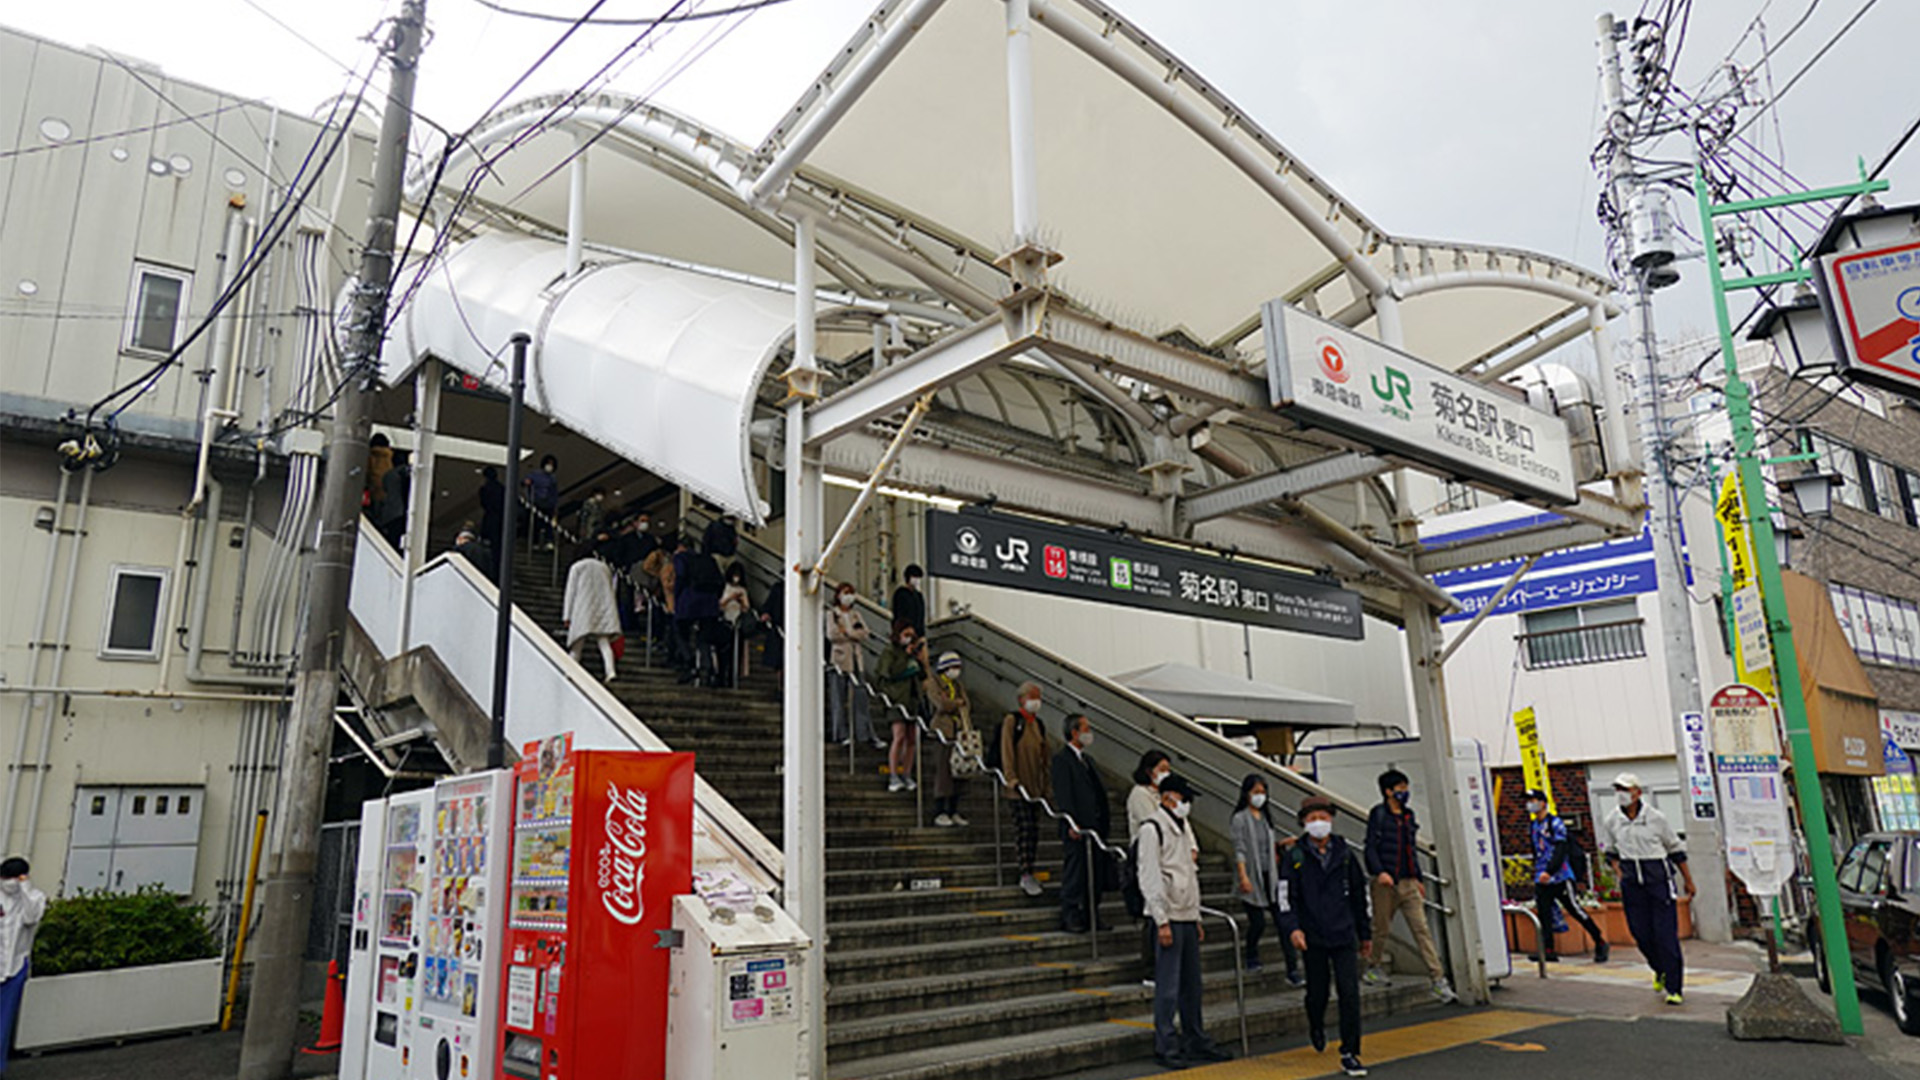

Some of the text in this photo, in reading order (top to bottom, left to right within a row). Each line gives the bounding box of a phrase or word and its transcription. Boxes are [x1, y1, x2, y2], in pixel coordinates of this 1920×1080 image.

[1311, 377, 1363, 411] 東急電鉄
[1371, 365, 1413, 411] JR
[1430, 381, 1535, 454] 菊名駅 東口
[1436, 423, 1474, 452] Kikuna
[1496, 444, 1519, 468] East
[1520, 454, 1561, 484] Entrance
[995, 537, 1030, 566] JR
[1048, 559, 1064, 576] 16
[1178, 570, 1240, 608] 菊名駅
[1241, 588, 1271, 613] 東口
[601, 779, 648, 925] Coca-Cola
